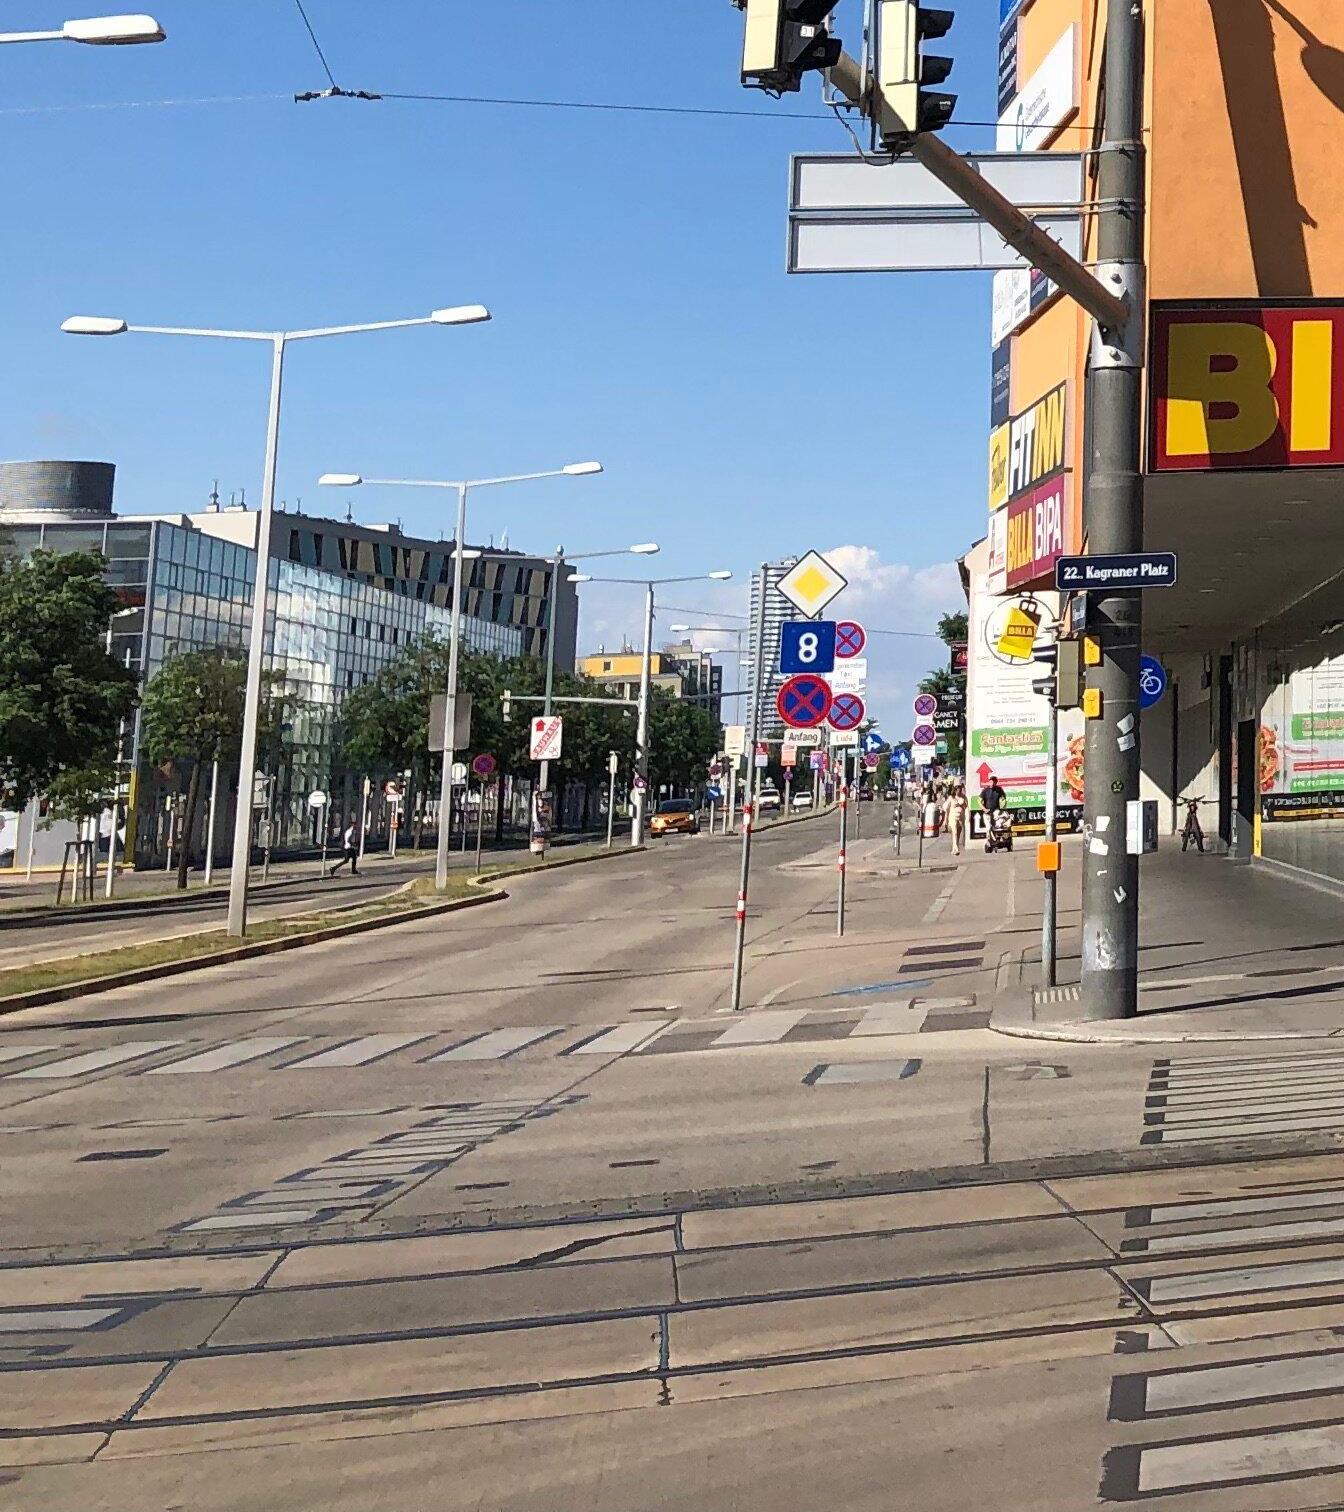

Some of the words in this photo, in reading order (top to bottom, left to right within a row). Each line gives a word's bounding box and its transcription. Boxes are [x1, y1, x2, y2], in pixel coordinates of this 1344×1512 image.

[1035, 491, 1062, 561] BIPA
[1008, 507, 1033, 573] BILLA
[1086, 565, 1138, 581] Kagraner
[1140, 562, 1169, 577] Platz
[1009, 626, 1034, 636] BILLA
[799, 632, 818, 663] 8
[789, 732, 818, 743] Anfang
